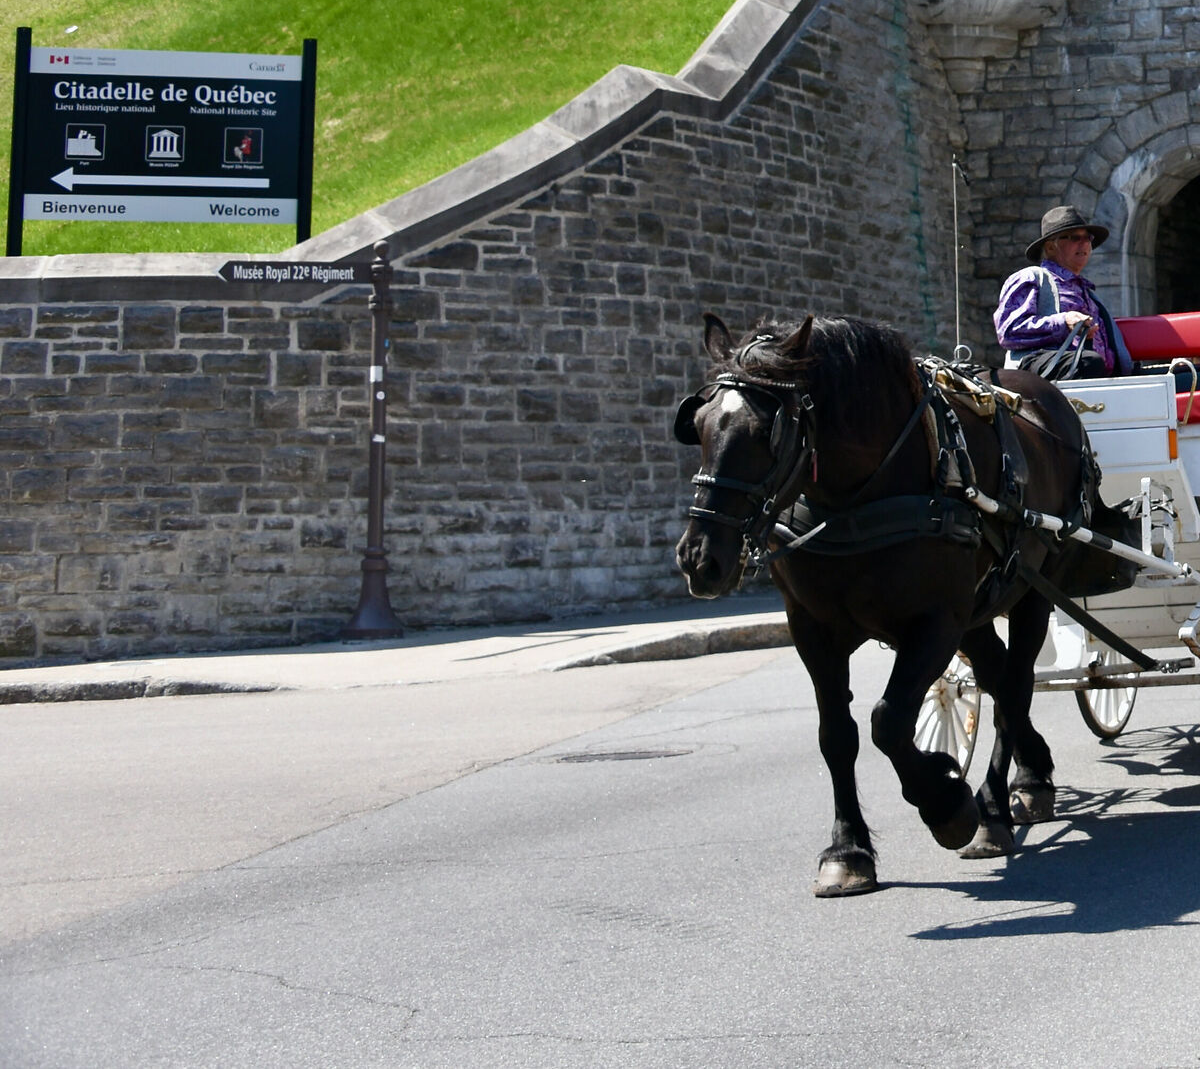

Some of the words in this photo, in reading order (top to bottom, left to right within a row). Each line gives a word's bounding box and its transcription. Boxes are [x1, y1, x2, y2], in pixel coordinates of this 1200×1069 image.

[249, 61, 285, 72] Canada
[54, 81, 154, 101] Citadelle
[161, 83, 188, 102] de
[195, 84, 277, 105] Québec
[55, 103, 74, 111] Lieu
[76, 103, 119, 114] historique
[121, 105, 156, 113] national
[190, 106, 225, 115] National
[227, 107, 259, 116] Historic
[261, 108, 277, 117] Site
[42, 201, 126, 215] Bienvenue
[209, 203, 280, 217] Welcome
[233, 265, 263, 279] Musée
[266, 265, 290, 282] Royal
[312, 266, 354, 282] Régiment
